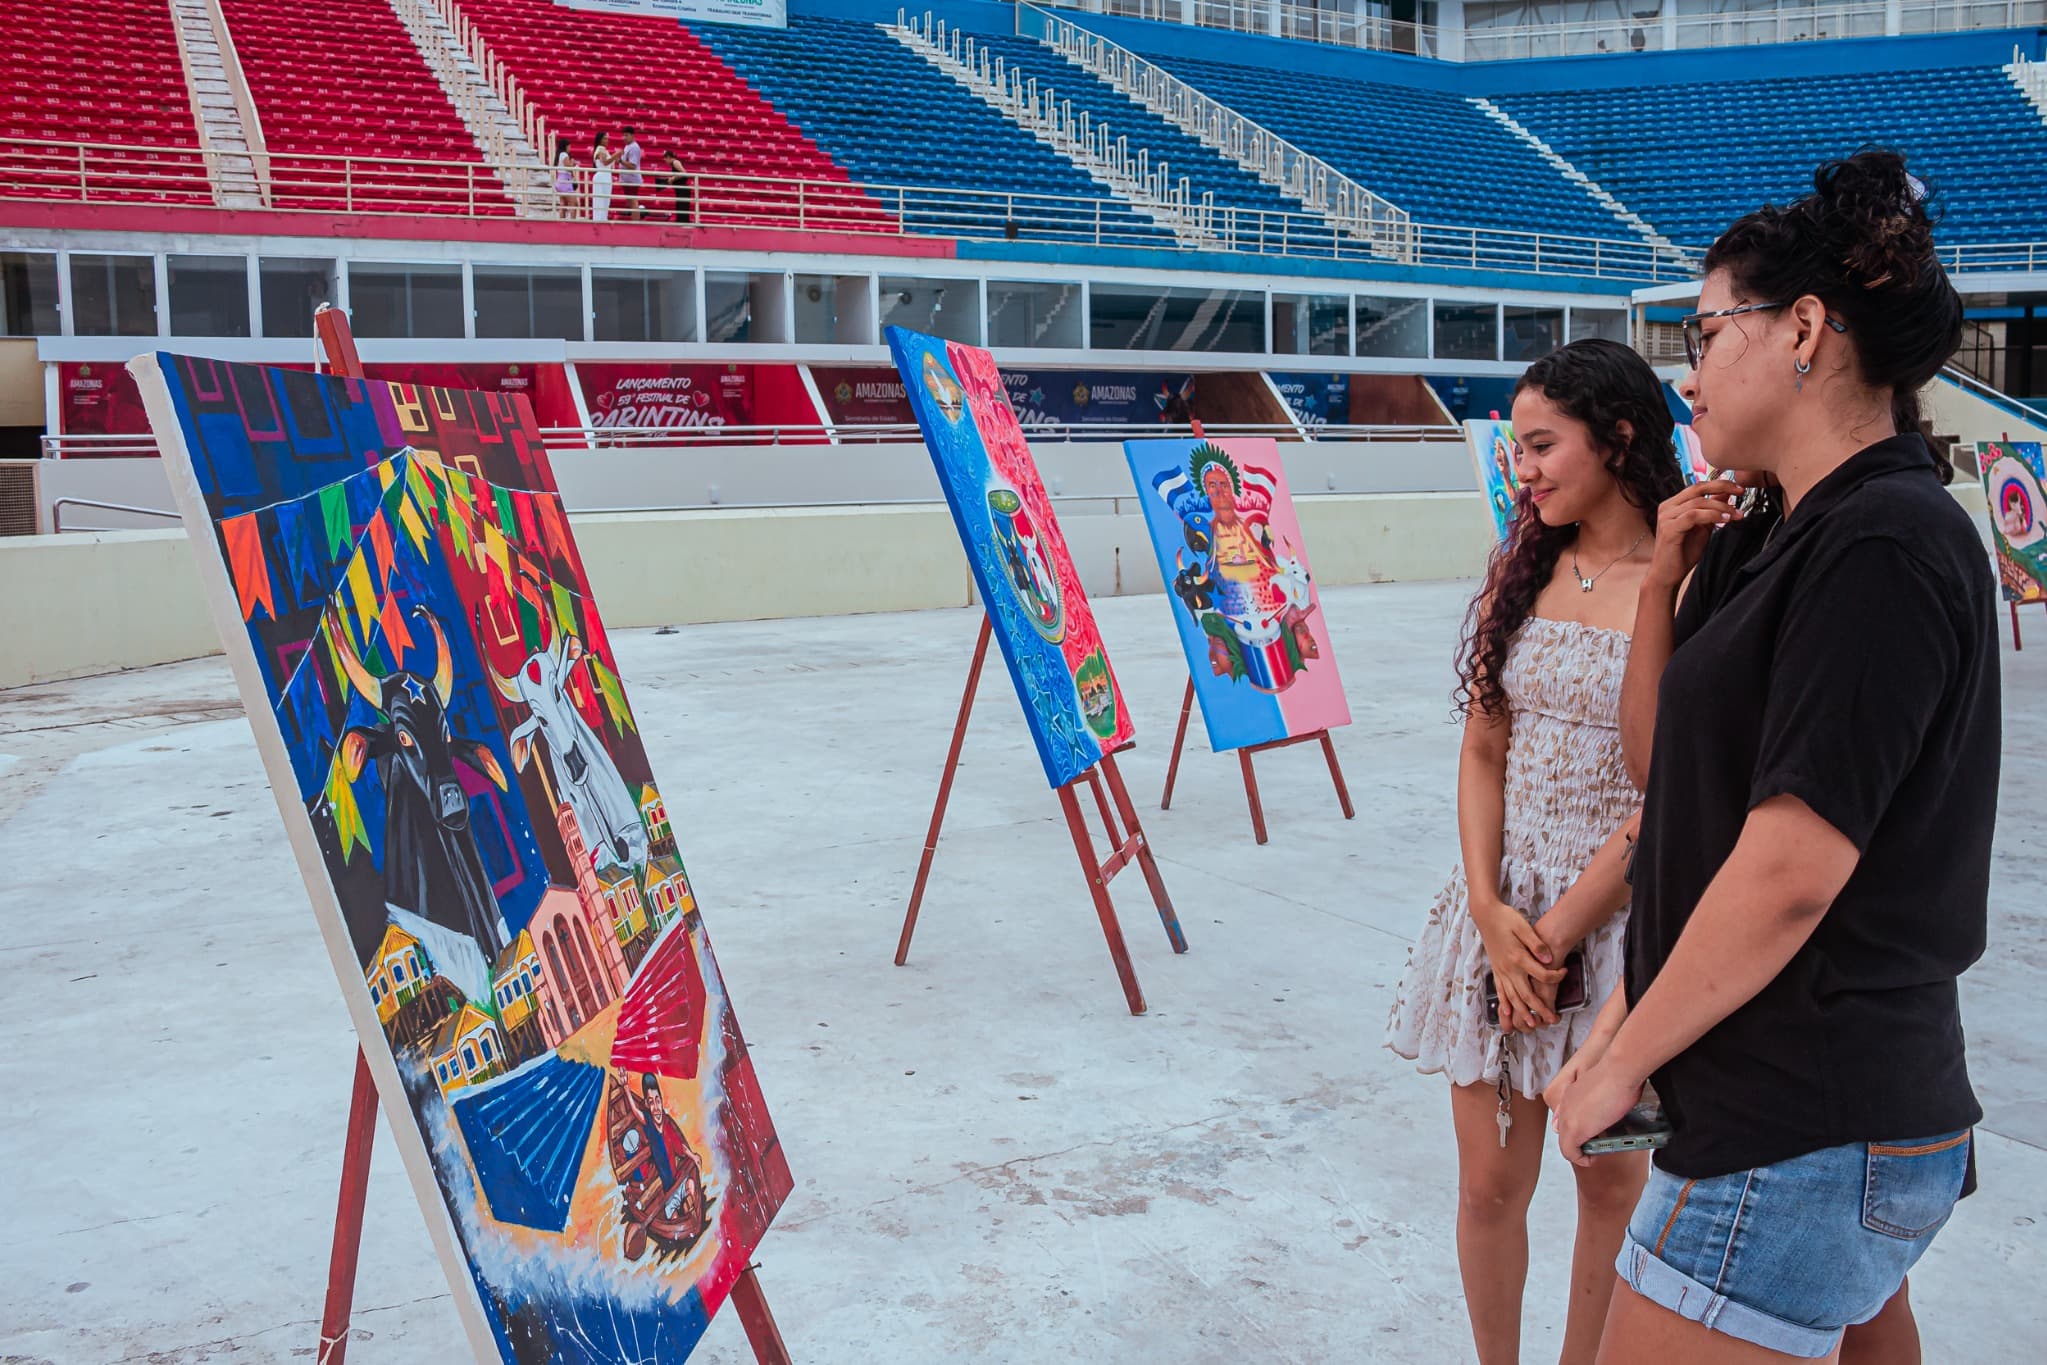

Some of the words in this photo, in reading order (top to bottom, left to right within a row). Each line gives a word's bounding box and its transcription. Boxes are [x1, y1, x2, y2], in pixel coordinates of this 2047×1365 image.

[616, 377, 692, 391] LANÇAMENTO
[855, 383, 906, 398] AMAZONAS
[675, 394, 691, 405] DE
[1091, 385, 1137, 401] AMAZONAS
